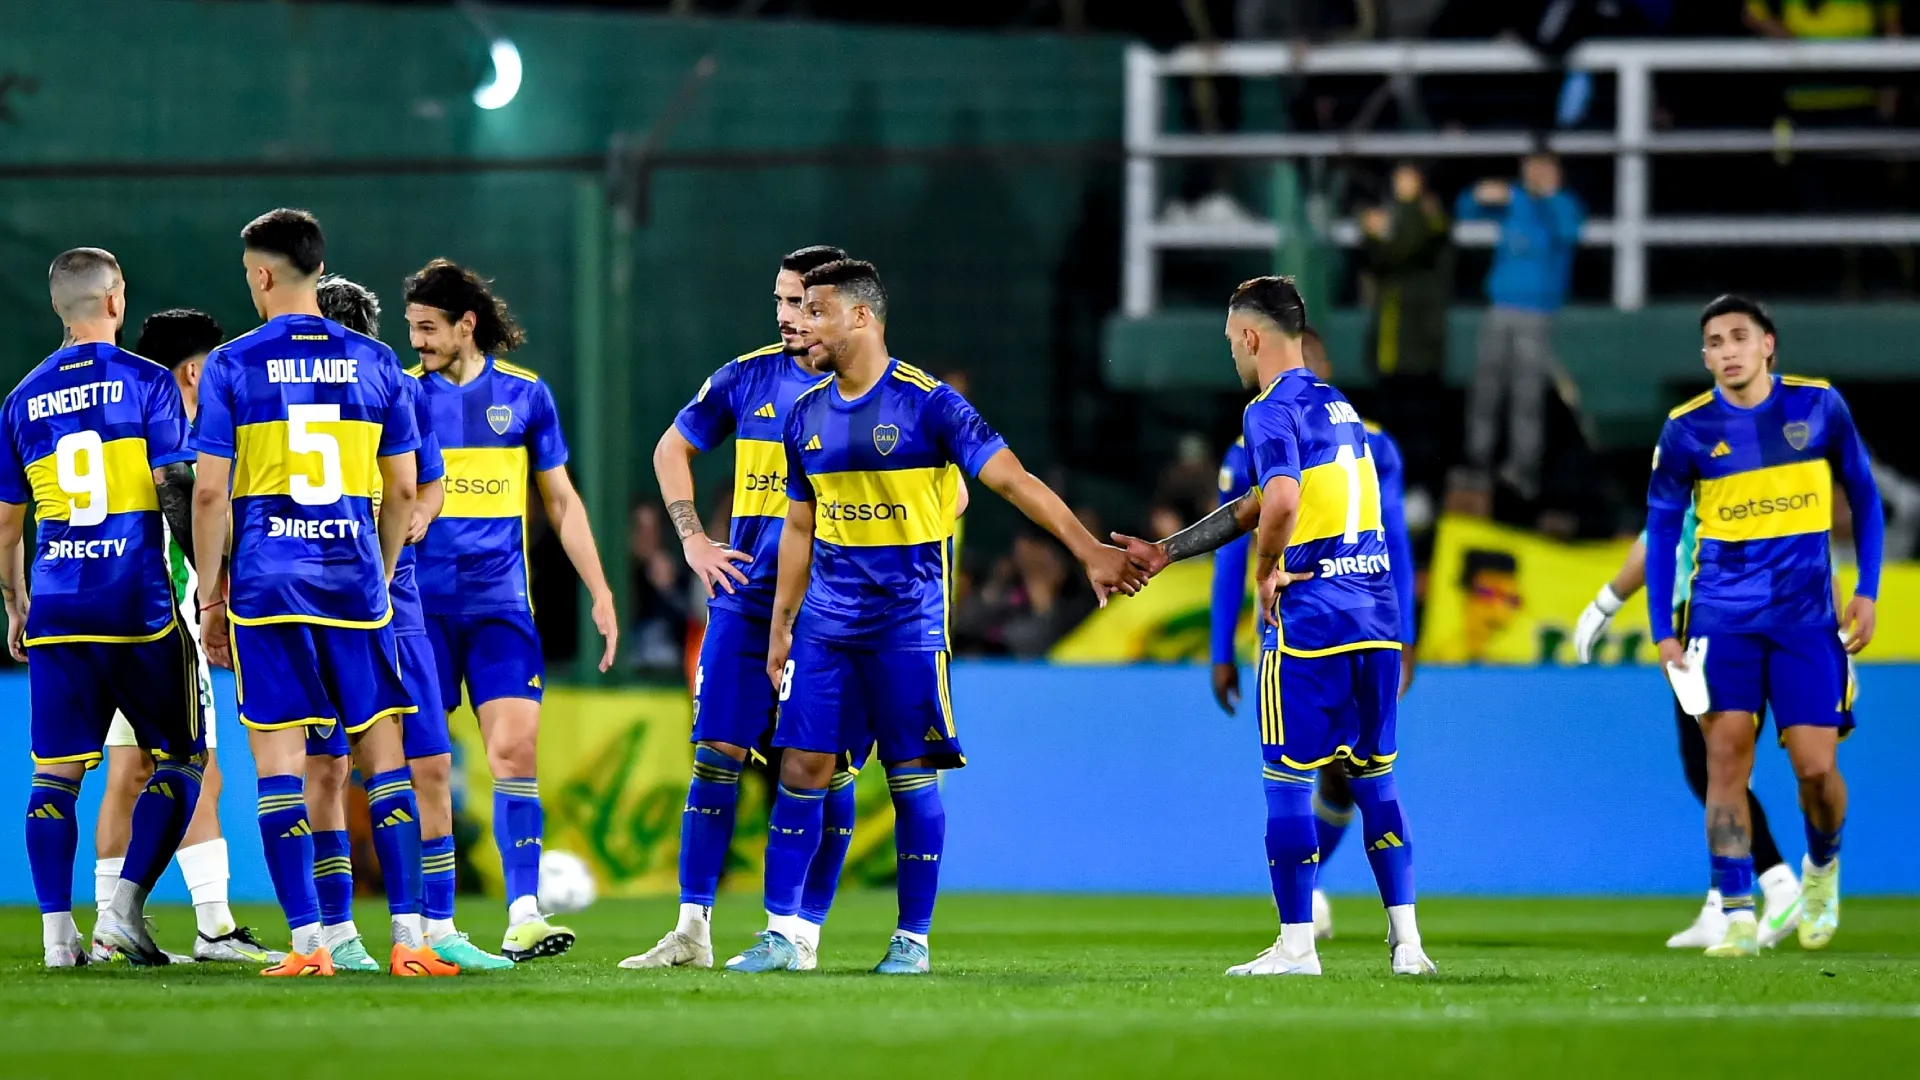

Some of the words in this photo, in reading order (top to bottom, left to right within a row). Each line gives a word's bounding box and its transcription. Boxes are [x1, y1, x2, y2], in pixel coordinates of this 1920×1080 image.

[59, 359, 94, 372] XENEIZE
[266, 358, 359, 384] BULLAUDE
[27, 380, 124, 422] BENEDETTO
[876, 434, 895, 442] CABJ
[287, 403, 342, 506] 5
[56, 429, 108, 527] 9
[443, 474, 511, 495] tsson
[745, 468, 788, 493] bets
[1335, 442, 1385, 544] 11
[1718, 492, 1820, 522] betsson
[267, 516, 360, 539] DIRECTV
[43, 537, 127, 561] DRECTV
